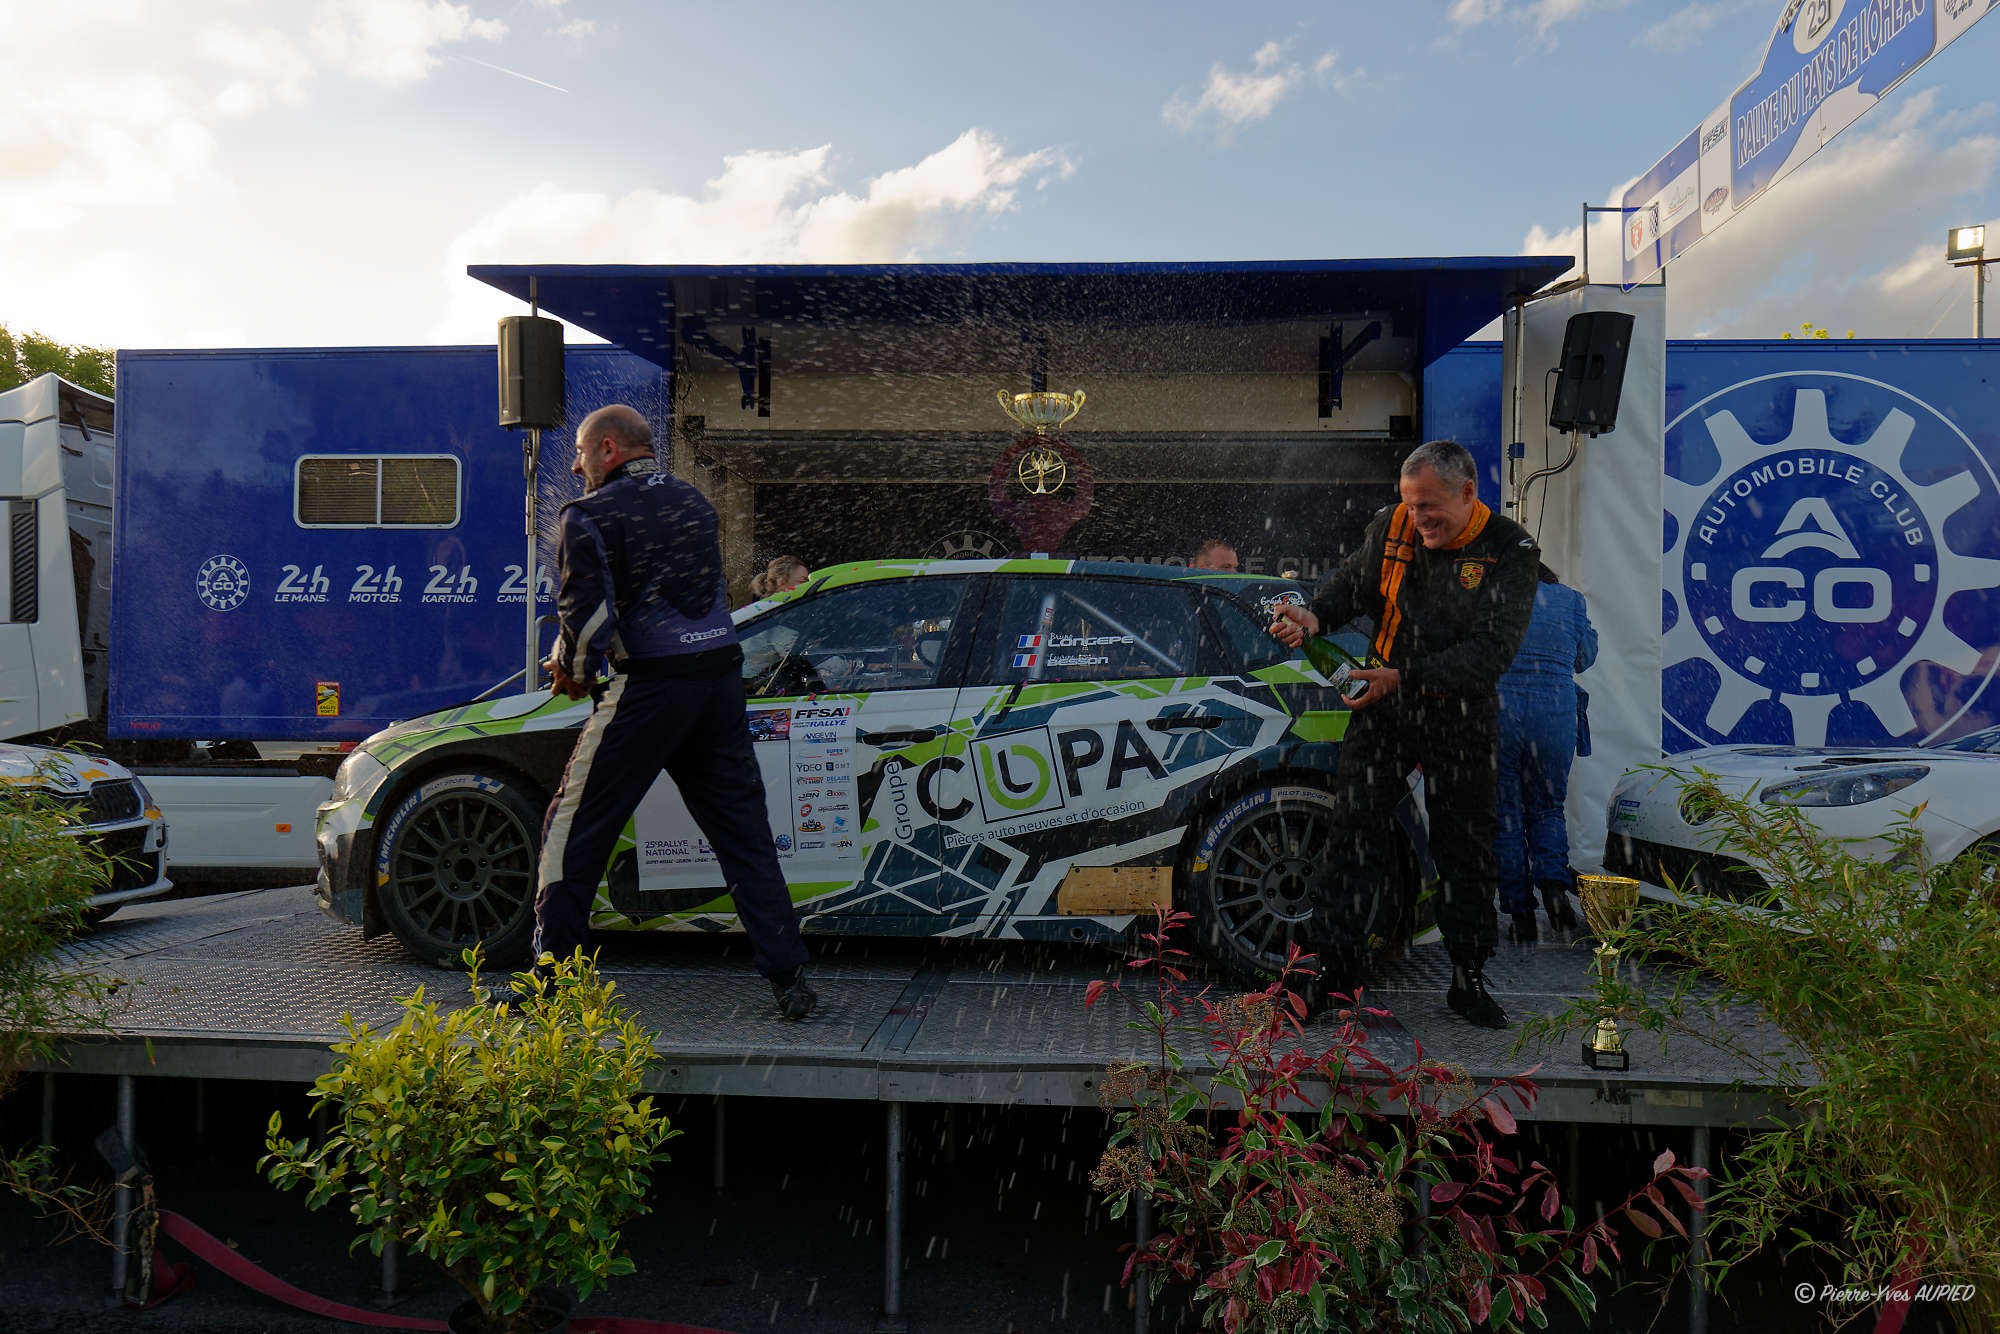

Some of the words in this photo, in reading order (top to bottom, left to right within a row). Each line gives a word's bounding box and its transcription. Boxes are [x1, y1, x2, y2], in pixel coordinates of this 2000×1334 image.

[1737, 90, 1778, 169] RALLYE
[1780, 72, 1799, 134] DU
[1801, 40, 1835, 116] PAYS
[1838, 16, 1857, 83] DE
[1699, 457, 1866, 545] AUTOMOBILE
[1870, 479, 1924, 546] CLUB
[276, 564, 330, 593] 24h
[351, 564, 402, 593] 24h
[423, 564, 478, 593] 24h
[274, 594, 290, 602] LE
[290, 594, 327, 602] MANS
[348, 594, 400, 602] MOTOS
[422, 594, 475, 603] KARTING
[496, 594, 550, 603] CAMINS
[795, 708, 844, 719] FFSA
[810, 719, 847, 728] RALLYE
[916, 719, 1169, 823] CUPA
[885, 761, 914, 840] Groupe
[381, 795, 418, 860] MICHELIN
[946, 829, 986, 847] Pièces
[988, 823, 1016, 840] auto
[1018, 817, 1061, 833] neuves
[1063, 812, 1078, 826] et
[1081, 800, 1146, 820] d'occasion
[1206, 792, 1266, 847] MICHELIN
[645, 848, 689, 856] NATIONAL
[658, 839, 688, 848] RALLYE
